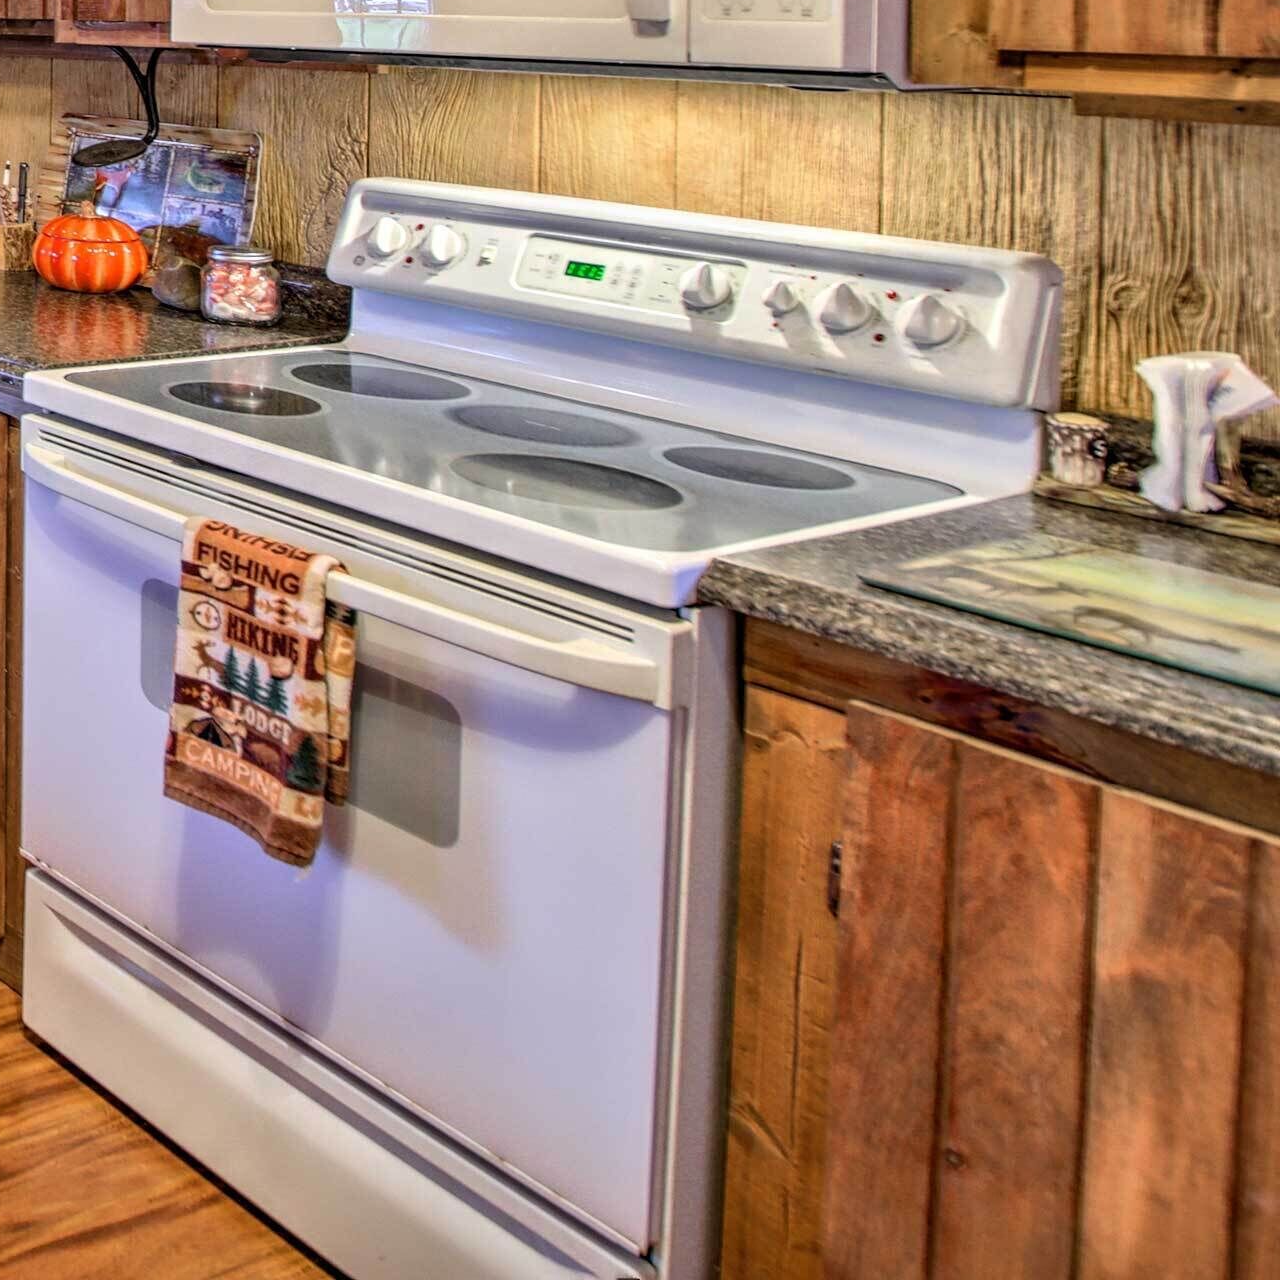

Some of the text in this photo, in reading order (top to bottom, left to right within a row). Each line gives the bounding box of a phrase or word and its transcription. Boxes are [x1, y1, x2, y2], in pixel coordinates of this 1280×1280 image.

[1093, 439, 1108, 458] S
[197, 541, 301, 595] FISHING
[226, 611, 300, 666] HIKING
